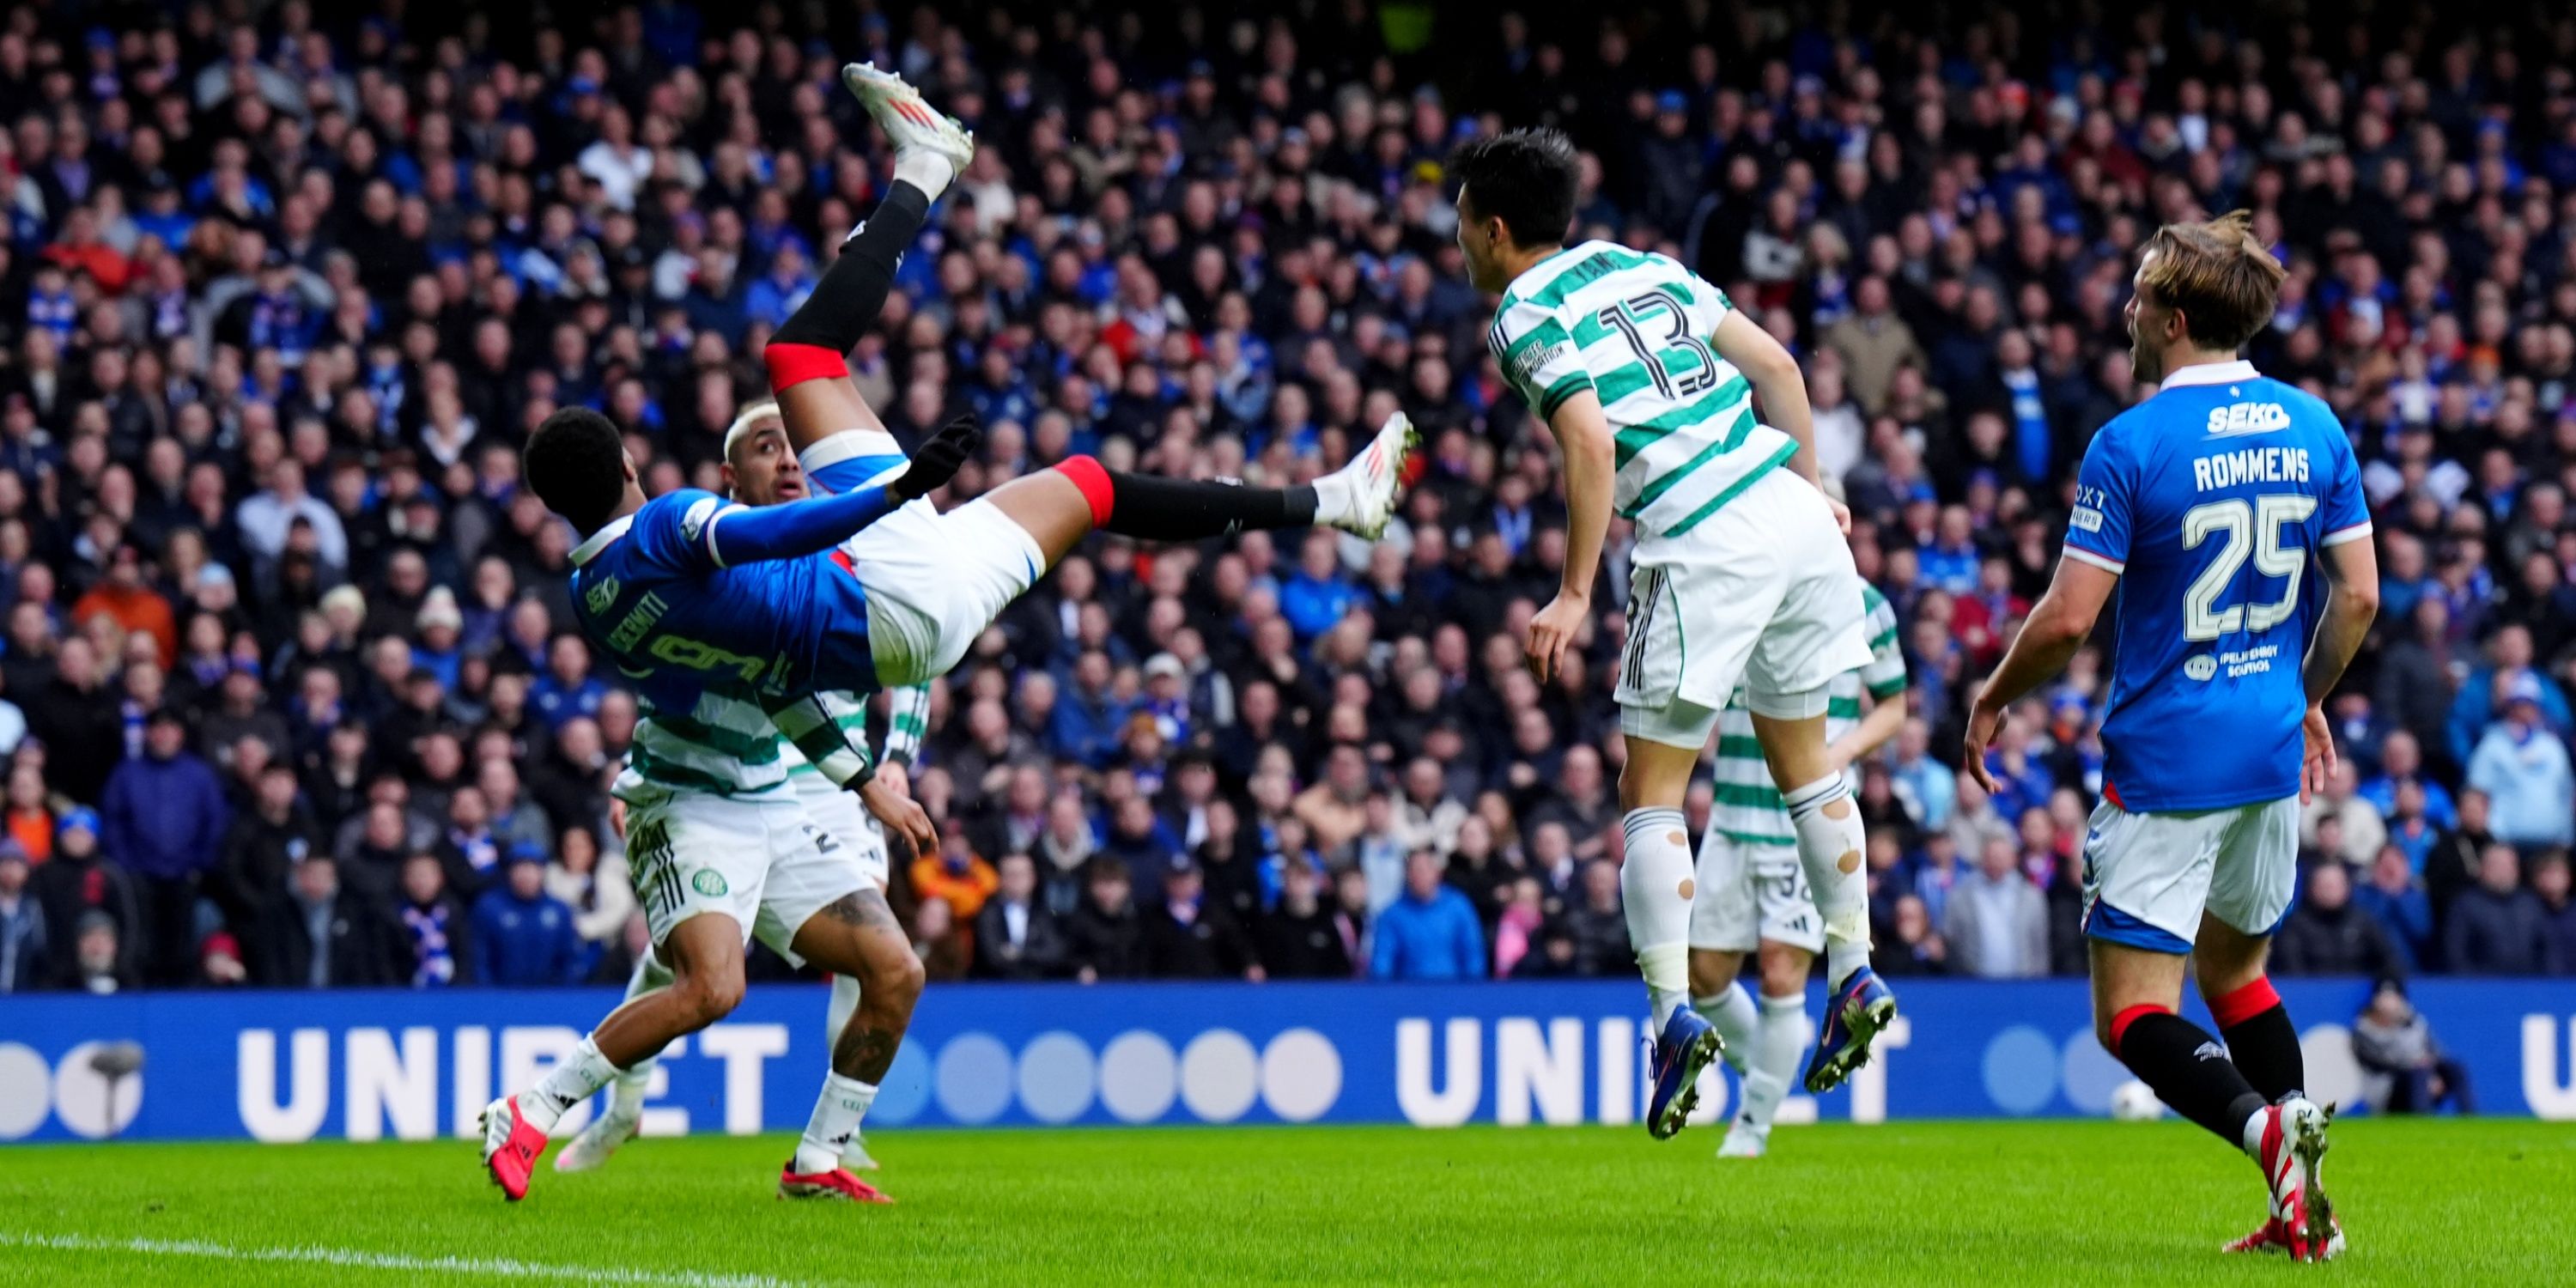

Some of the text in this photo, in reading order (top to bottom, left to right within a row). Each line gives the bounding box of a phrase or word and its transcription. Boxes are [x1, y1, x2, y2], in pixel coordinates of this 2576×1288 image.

[1599, 290, 1718, 400] 13
[2193, 447, 2309, 492] ROMMENS
[2206, 402, 2291, 434] SEKO
[2182, 495, 2317, 641] 25
[1396, 1017, 1911, 1127] UNIT
